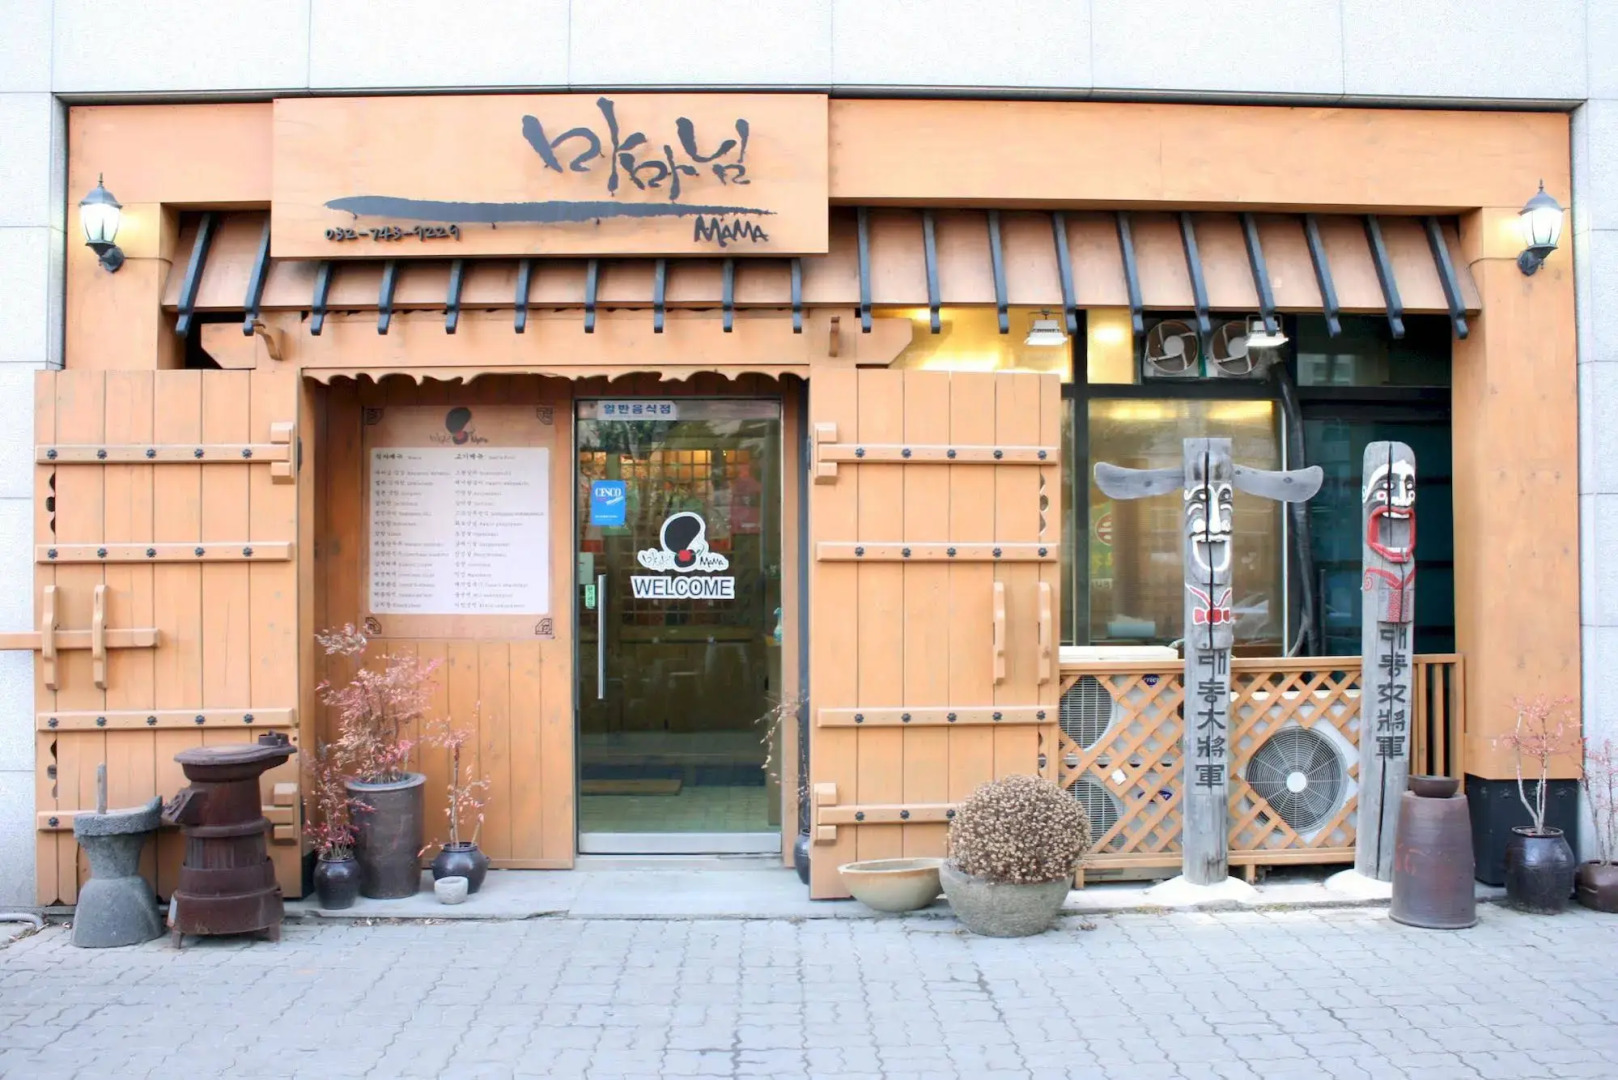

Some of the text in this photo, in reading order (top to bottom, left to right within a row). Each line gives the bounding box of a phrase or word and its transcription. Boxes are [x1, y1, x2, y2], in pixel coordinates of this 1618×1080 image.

[522, 97, 751, 202] 마마님
[325, 224, 461, 241] 032-743-9229
[604, 404, 671, 414] 일반음식점
[634, 579, 732, 595] WELCOME
